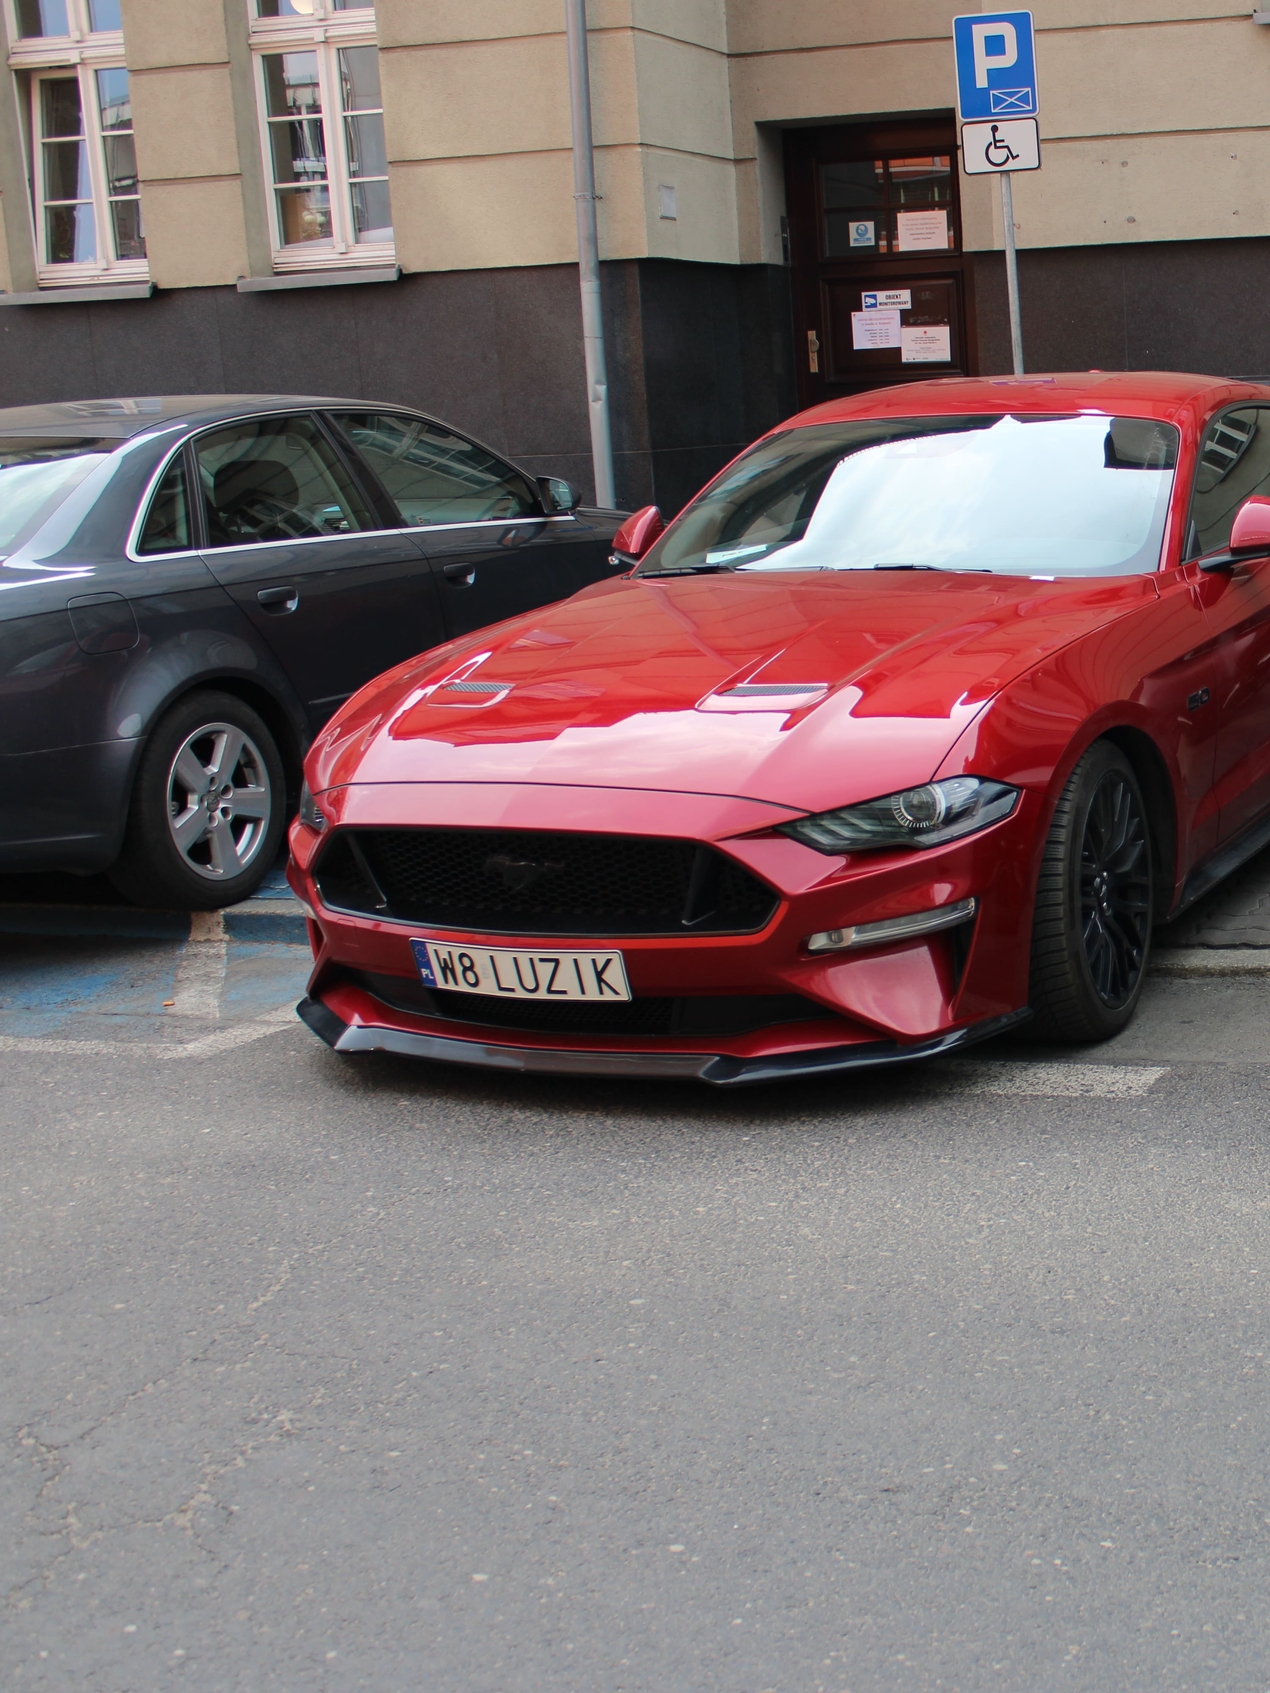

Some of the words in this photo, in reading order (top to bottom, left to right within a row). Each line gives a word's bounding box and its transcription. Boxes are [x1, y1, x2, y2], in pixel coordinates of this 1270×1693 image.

[971, 22, 1018, 88] P
[420, 967, 435, 980] PL
[434, 948, 479, 988] W8
[489, 954, 621, 996] LUZIK
